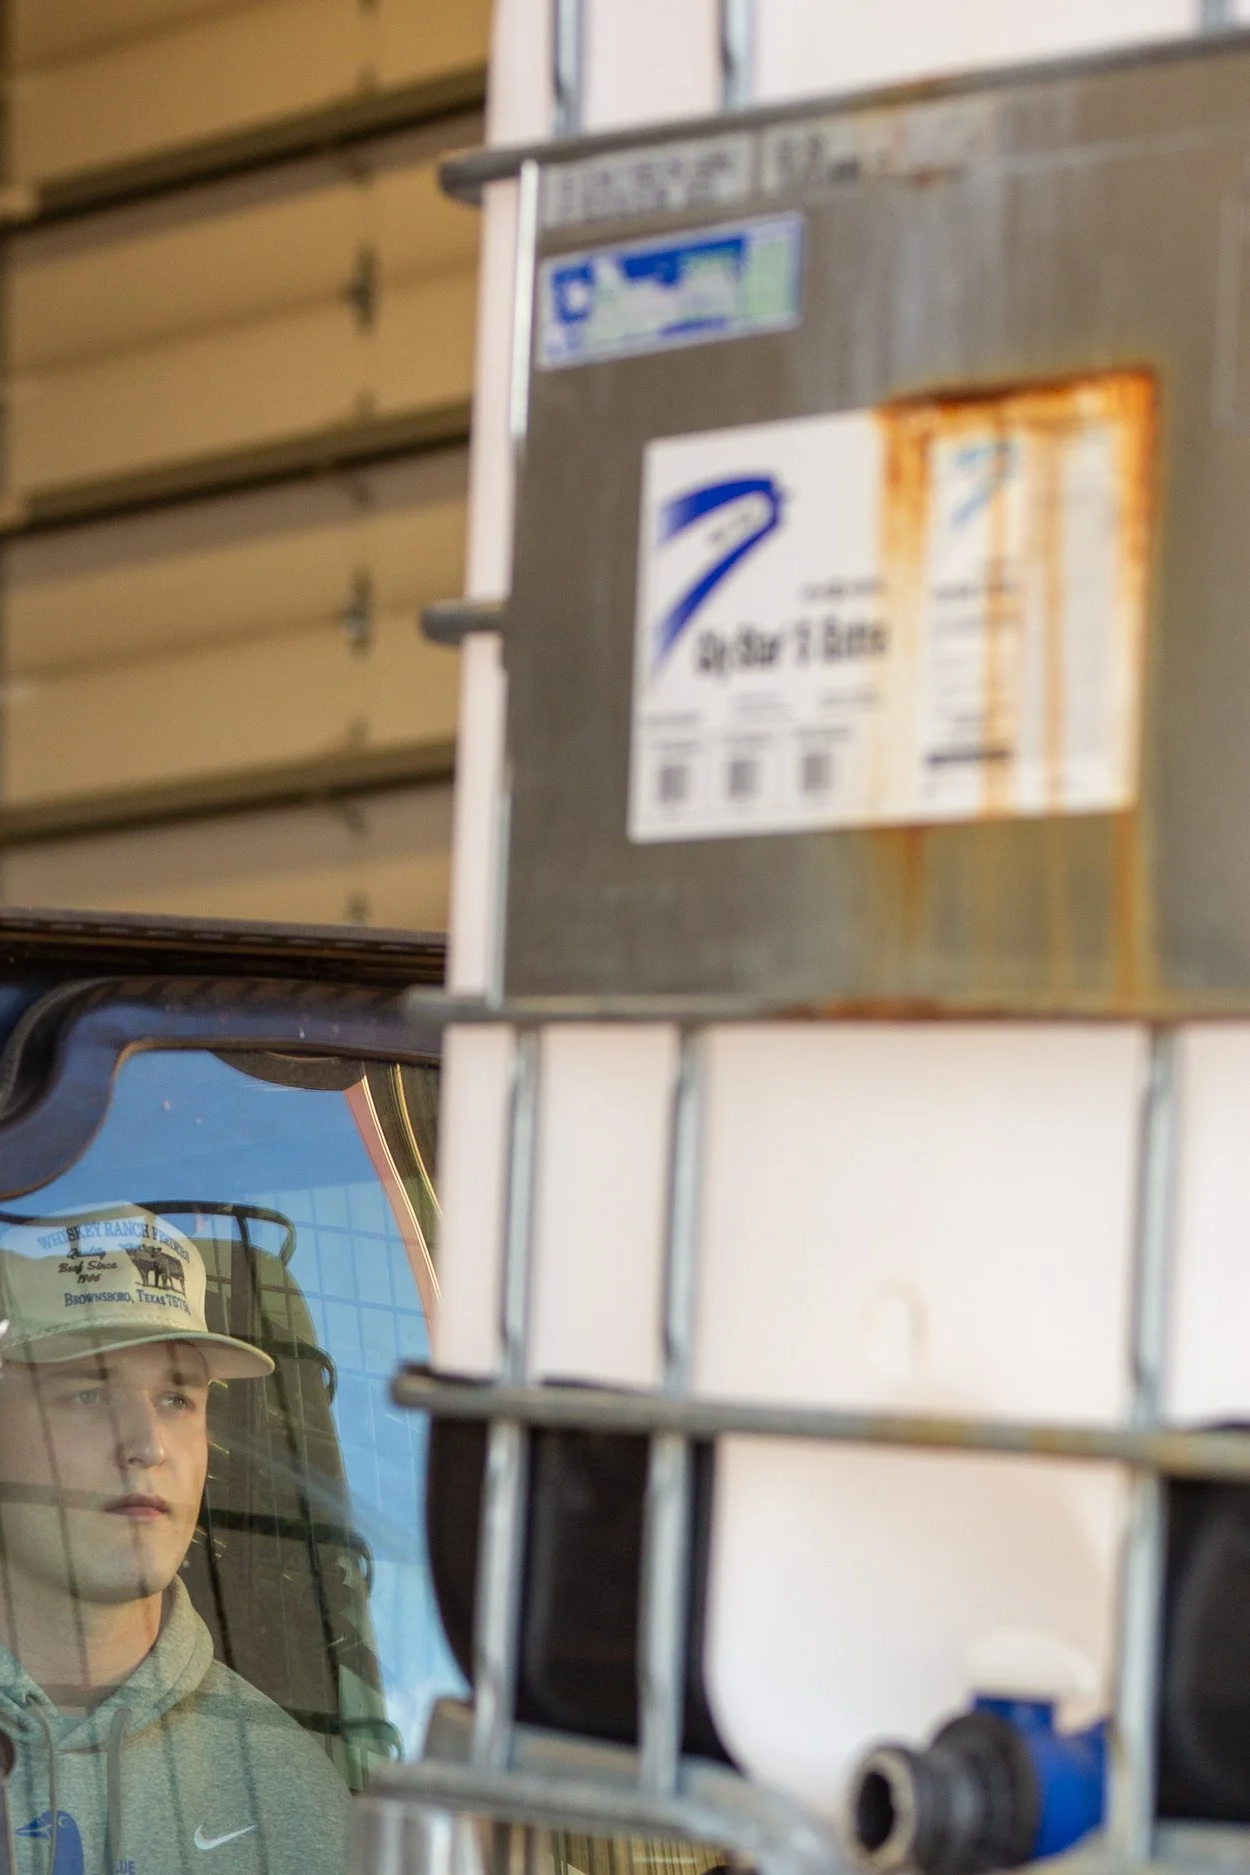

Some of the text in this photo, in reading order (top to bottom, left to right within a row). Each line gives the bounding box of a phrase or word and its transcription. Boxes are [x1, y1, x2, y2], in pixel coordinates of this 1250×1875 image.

[37, 1223, 100, 1250] WHISKEY
[104, 1221, 150, 1239] RANCH
[58, 1260, 117, 1274] Beef Since
